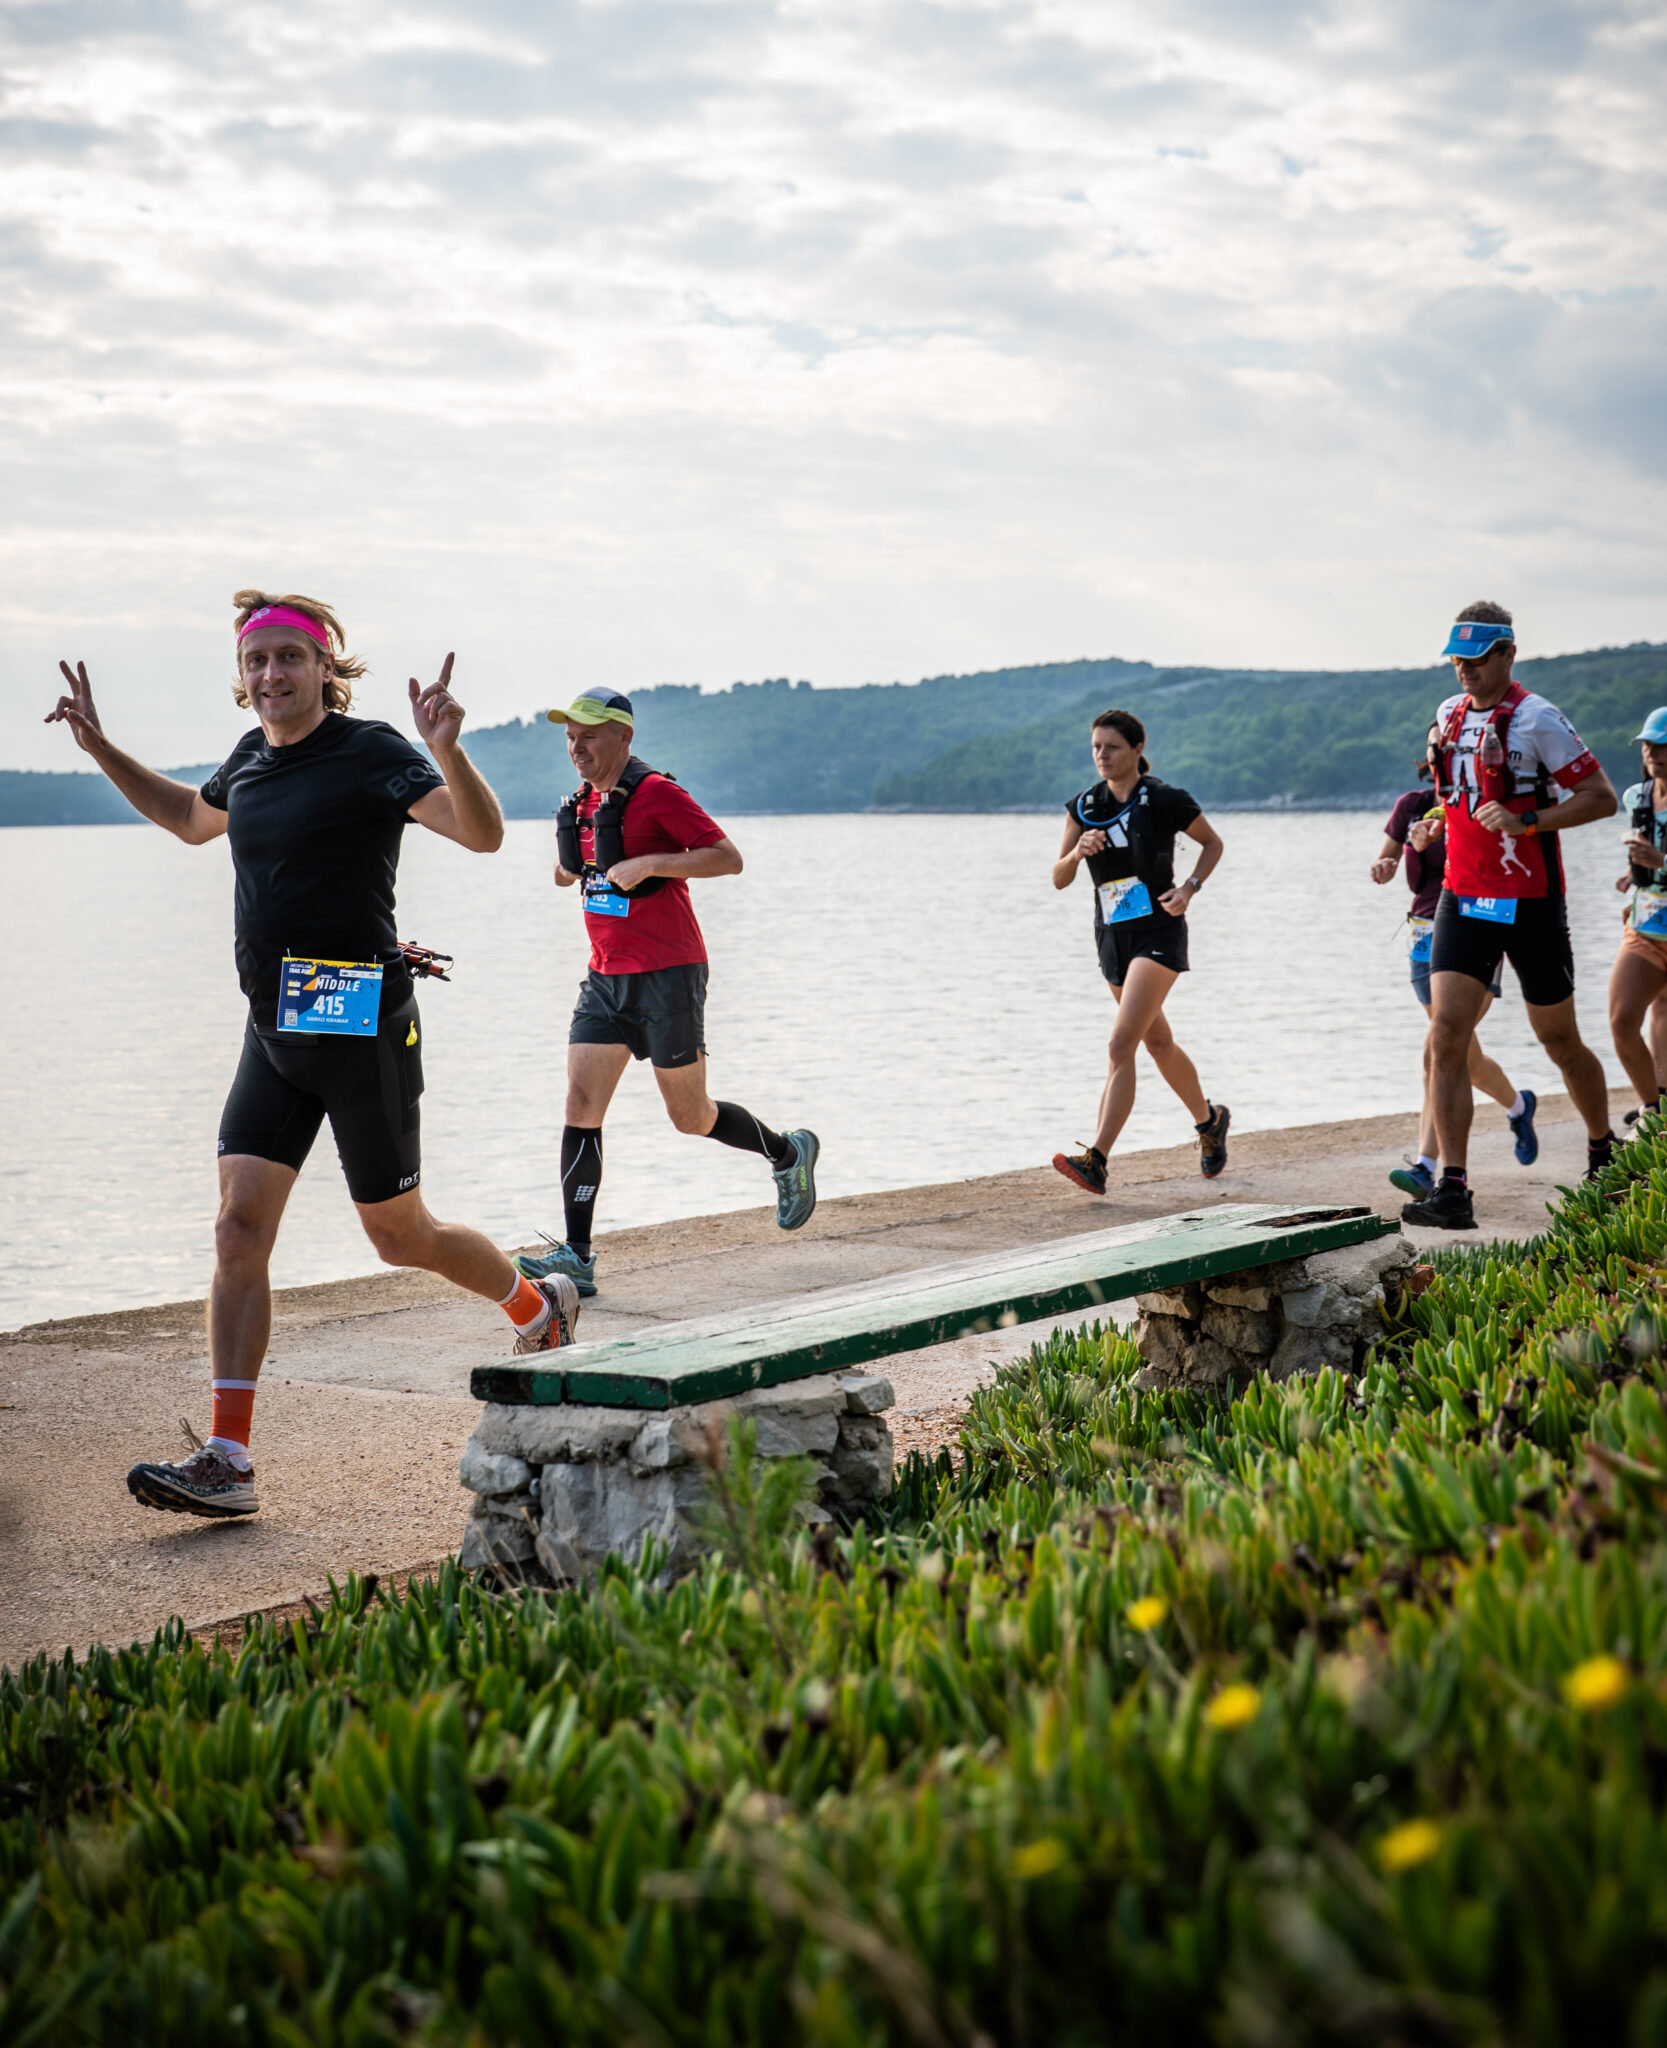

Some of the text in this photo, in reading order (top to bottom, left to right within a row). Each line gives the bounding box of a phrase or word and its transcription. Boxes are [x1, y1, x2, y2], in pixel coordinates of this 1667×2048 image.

[1476, 896, 1496, 909] 447
[315, 978, 360, 991] MIDDLE
[313, 995, 344, 1015] 415
